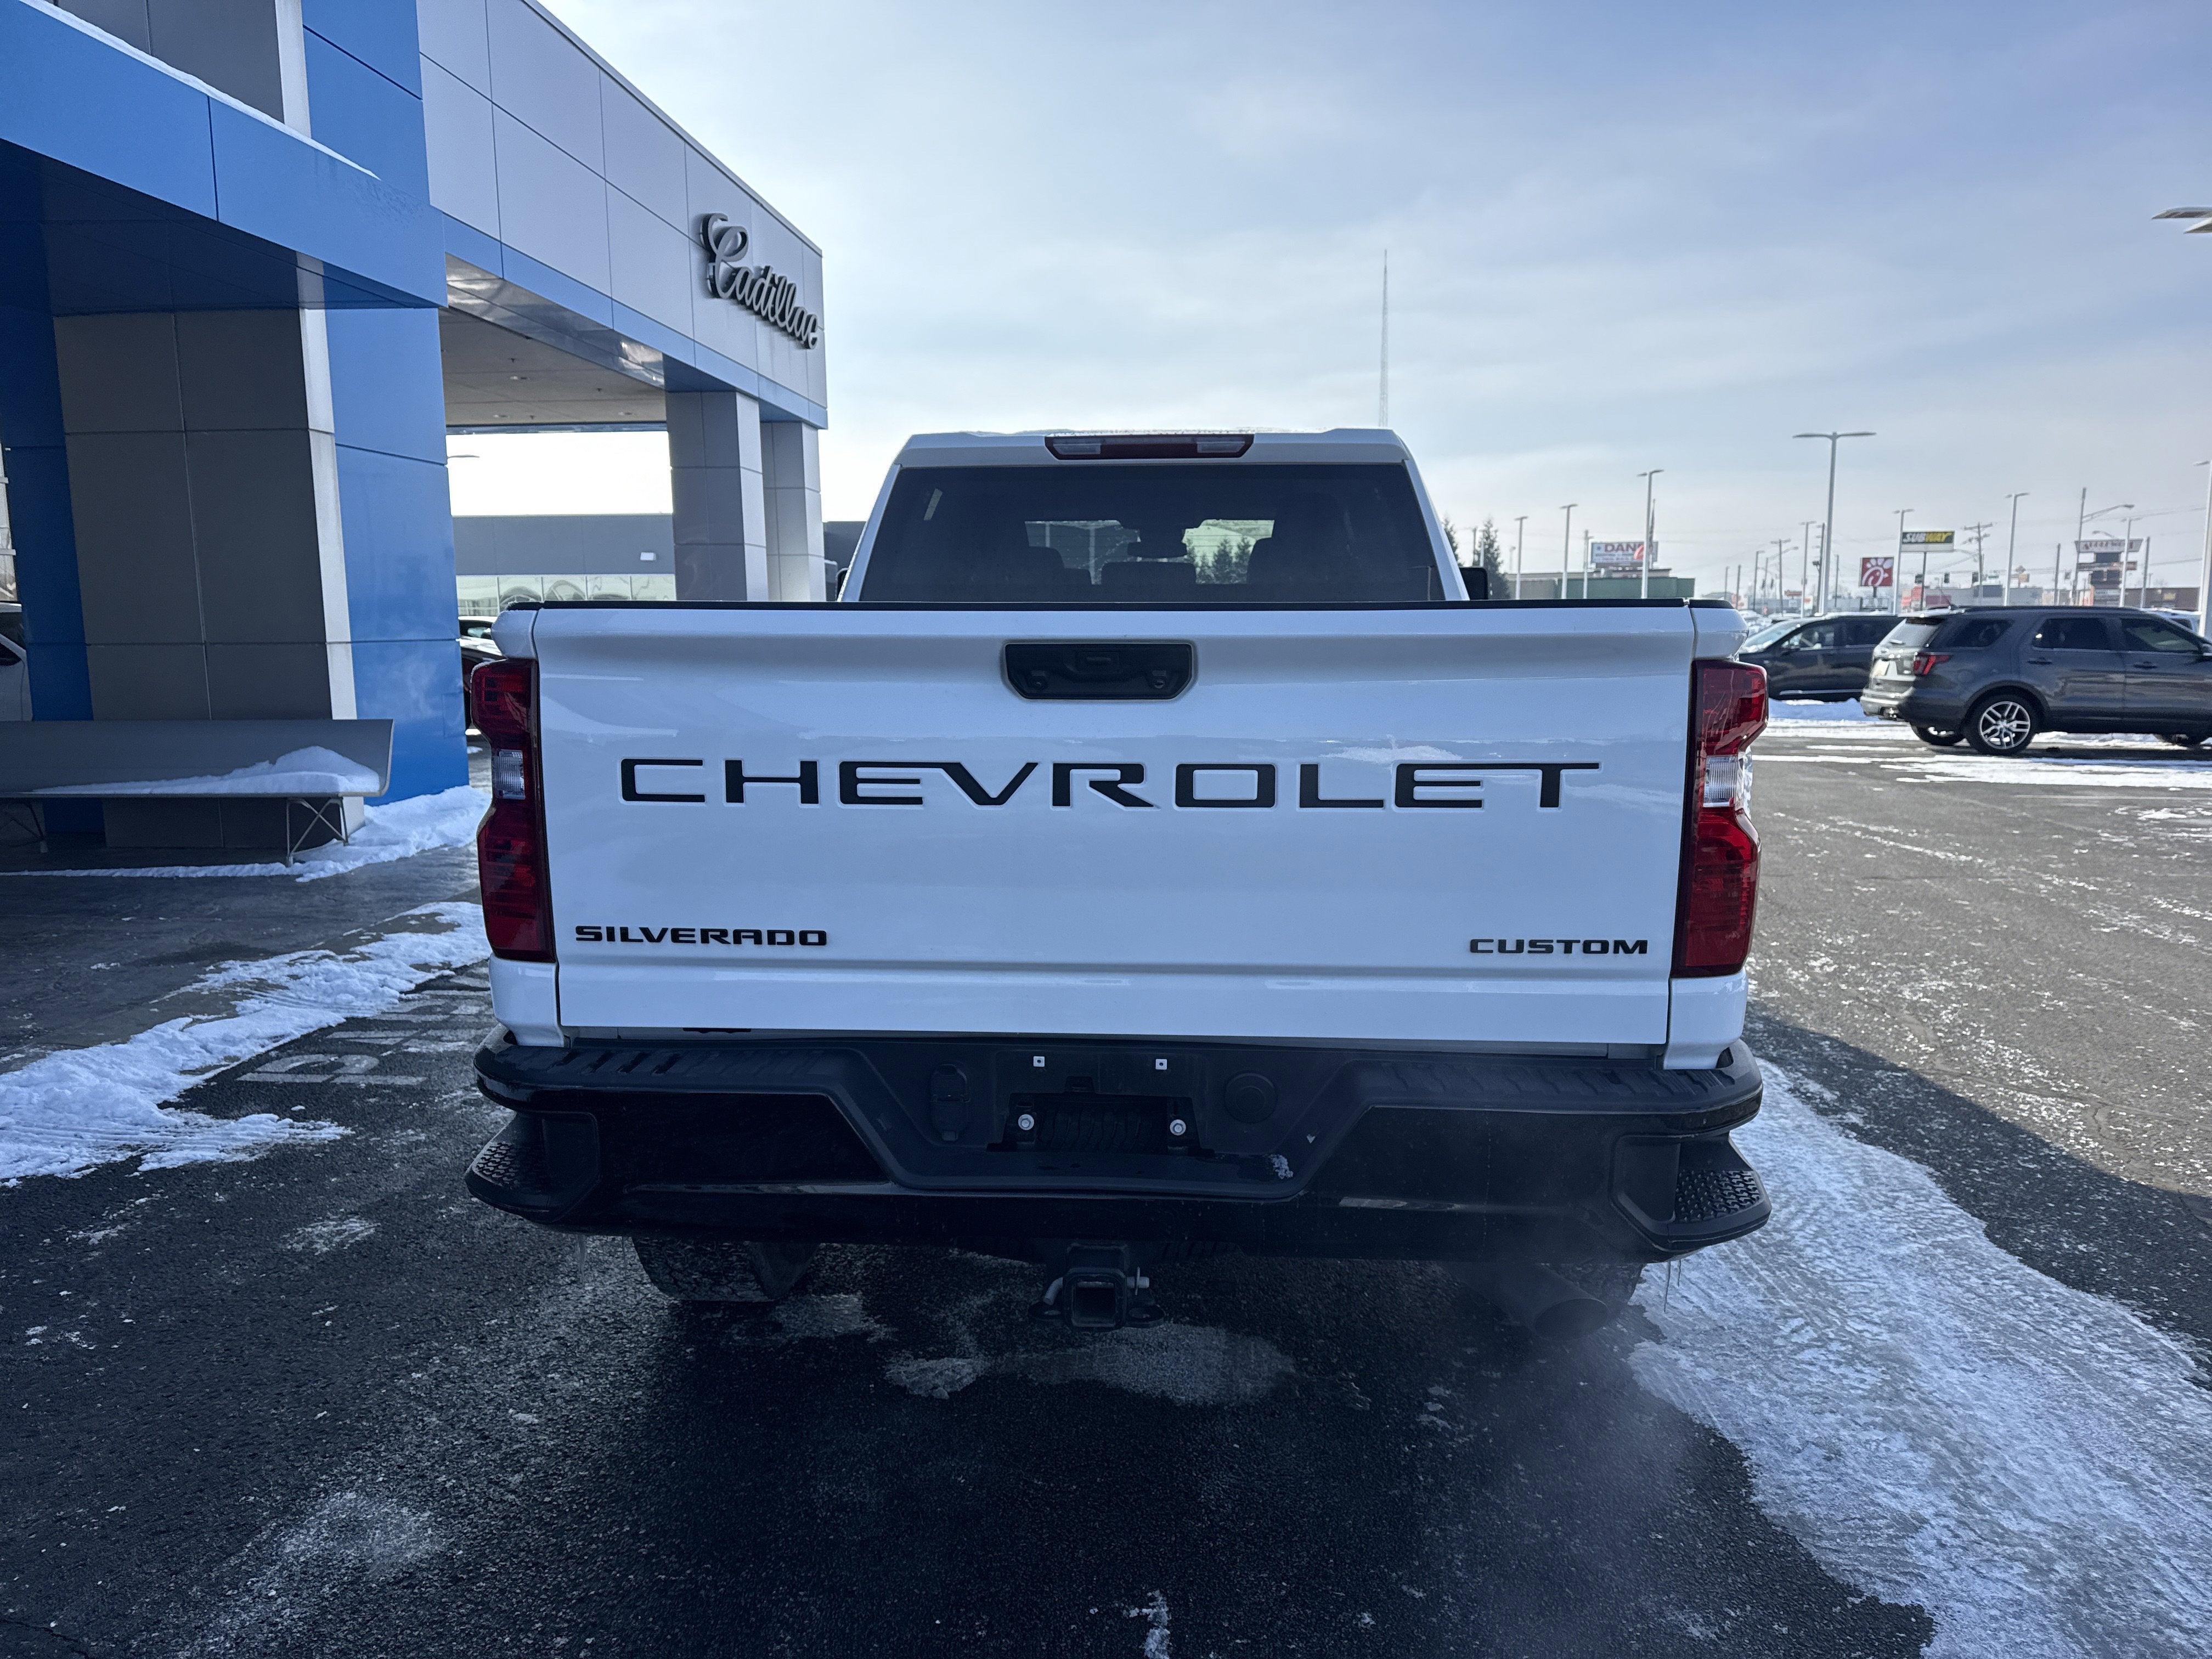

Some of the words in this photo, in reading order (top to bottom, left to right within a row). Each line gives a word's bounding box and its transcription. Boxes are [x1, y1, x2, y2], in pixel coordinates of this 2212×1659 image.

[700, 212, 818, 349] Cadillac
[621, 759, 1600, 809] CHEVROLET
[574, 926, 827, 946] SILVERADO
[1469, 939, 1648, 955] CUSTOM
